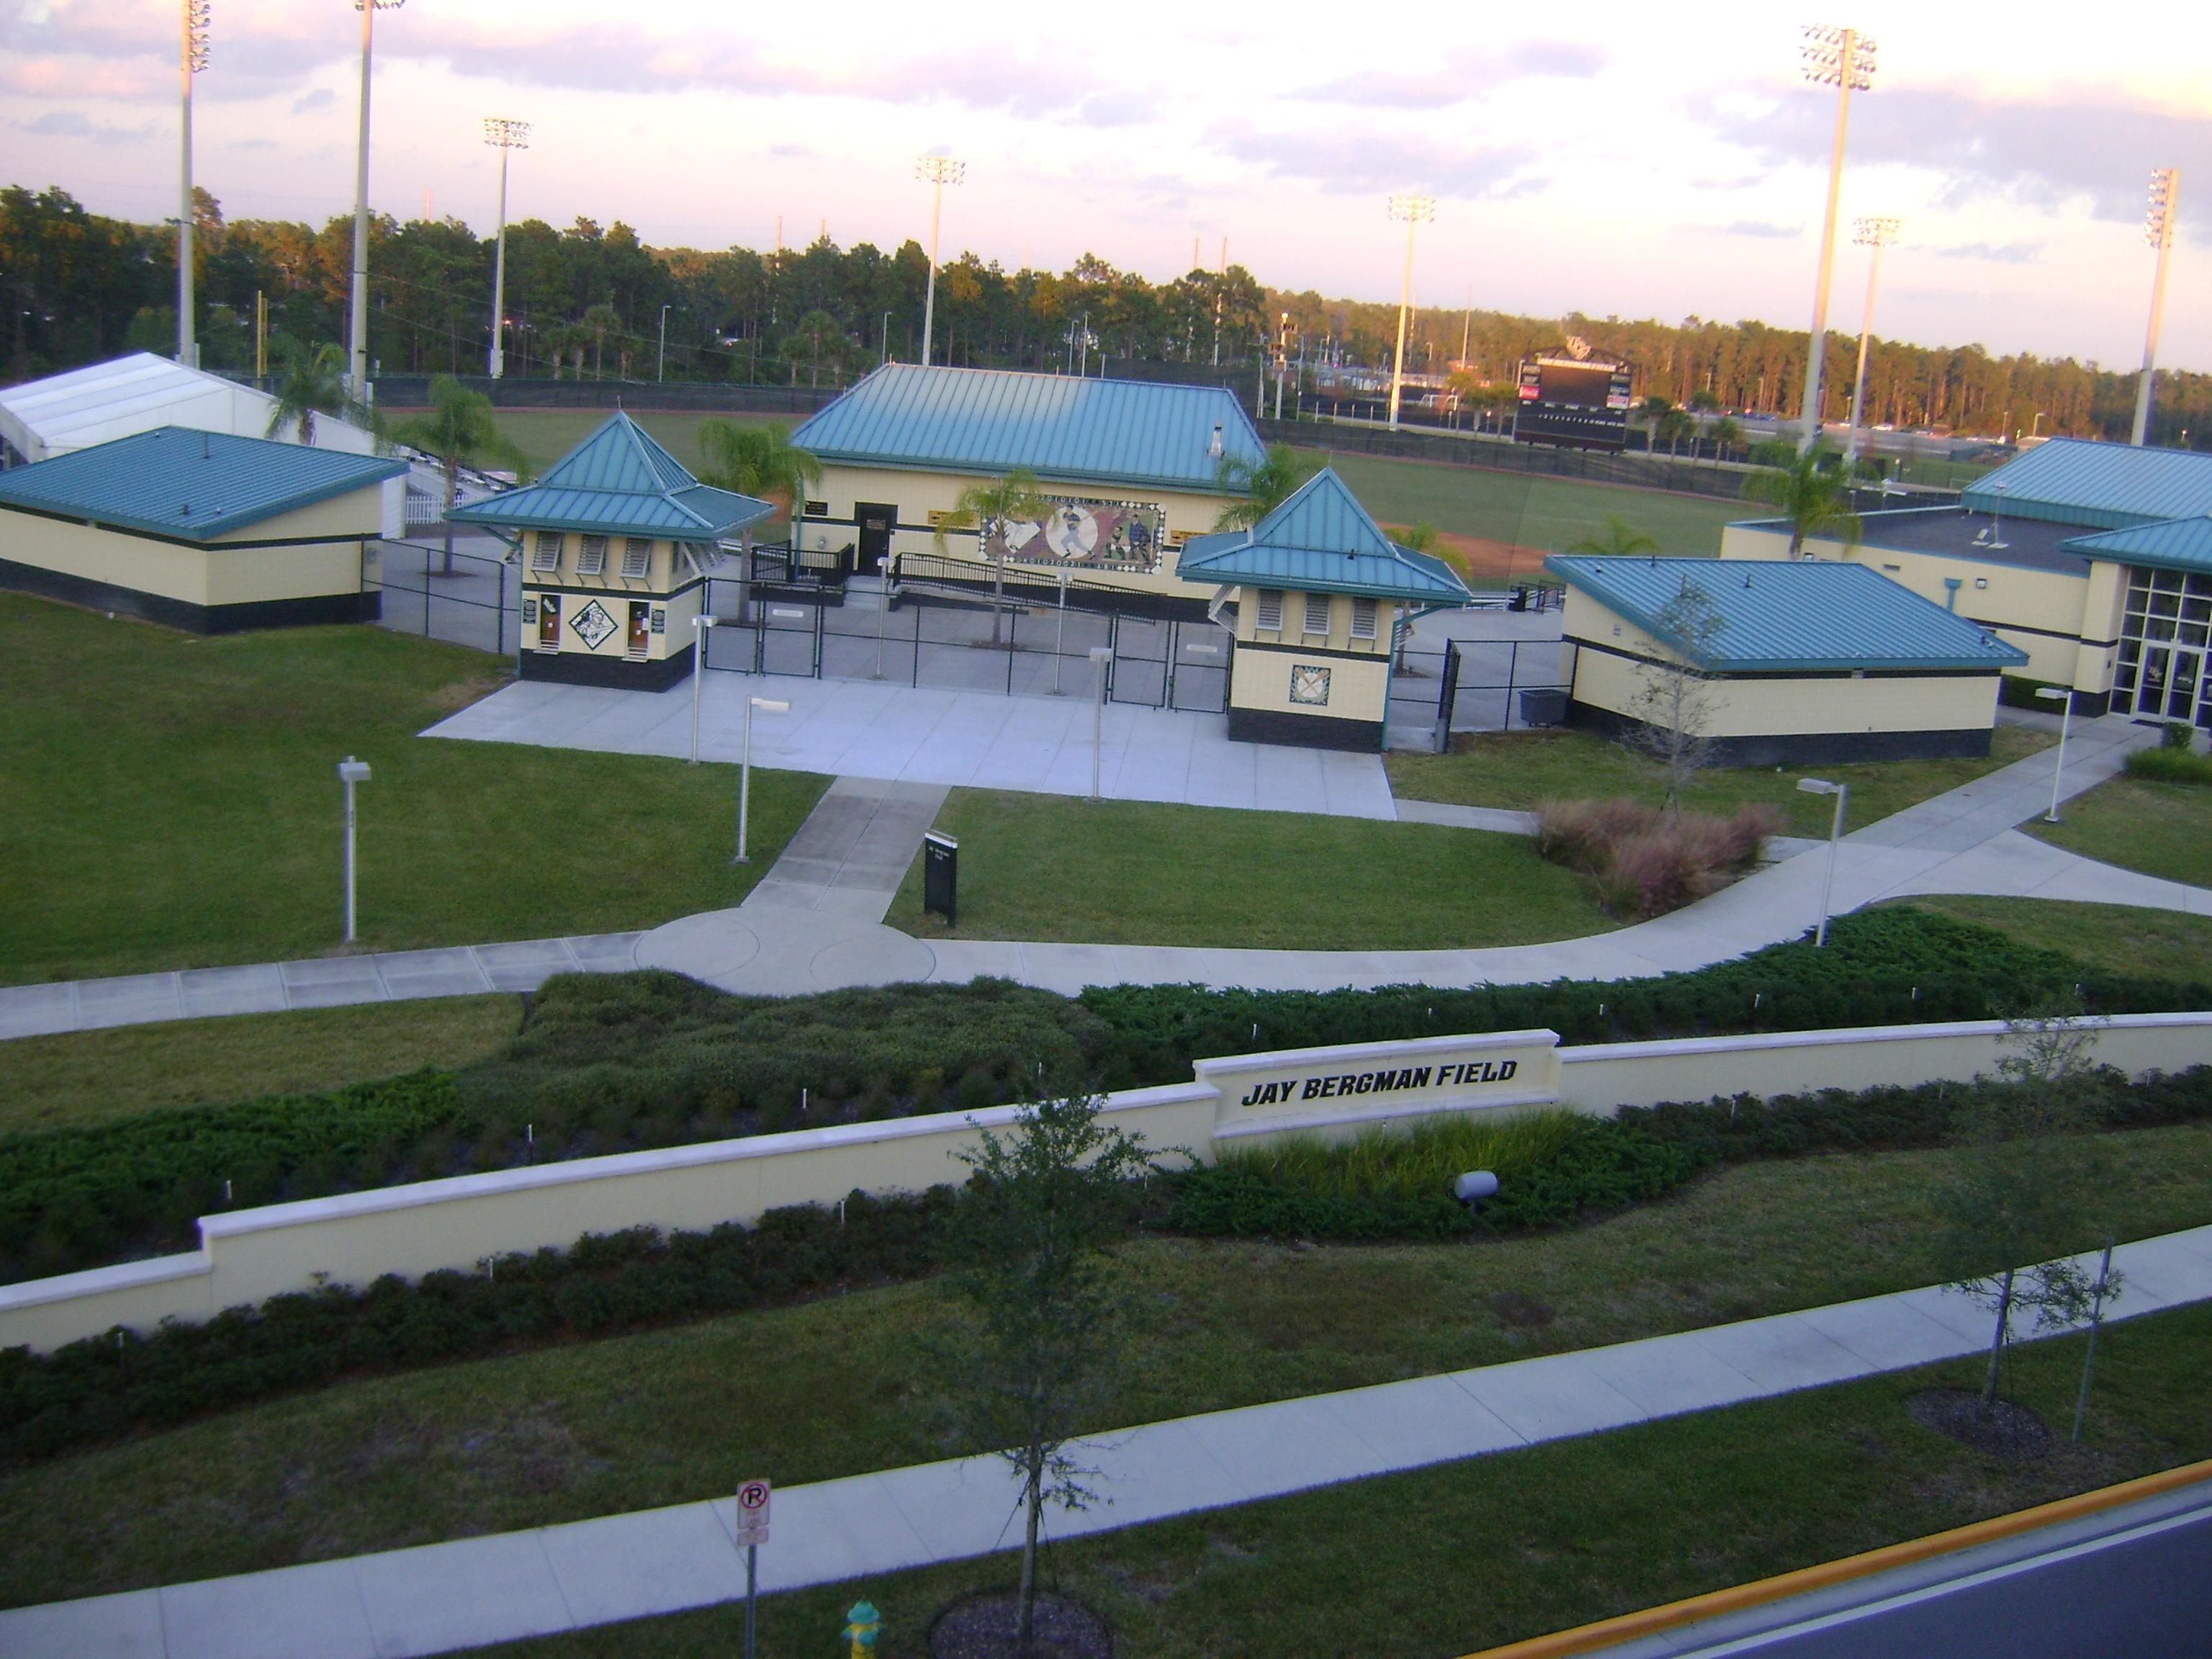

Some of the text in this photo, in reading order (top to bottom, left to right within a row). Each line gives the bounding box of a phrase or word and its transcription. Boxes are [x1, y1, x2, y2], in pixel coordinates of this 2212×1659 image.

[1241, 1060, 1519, 1107] JAY BERGMAN FIELD
[748, 1487, 762, 1504] P
